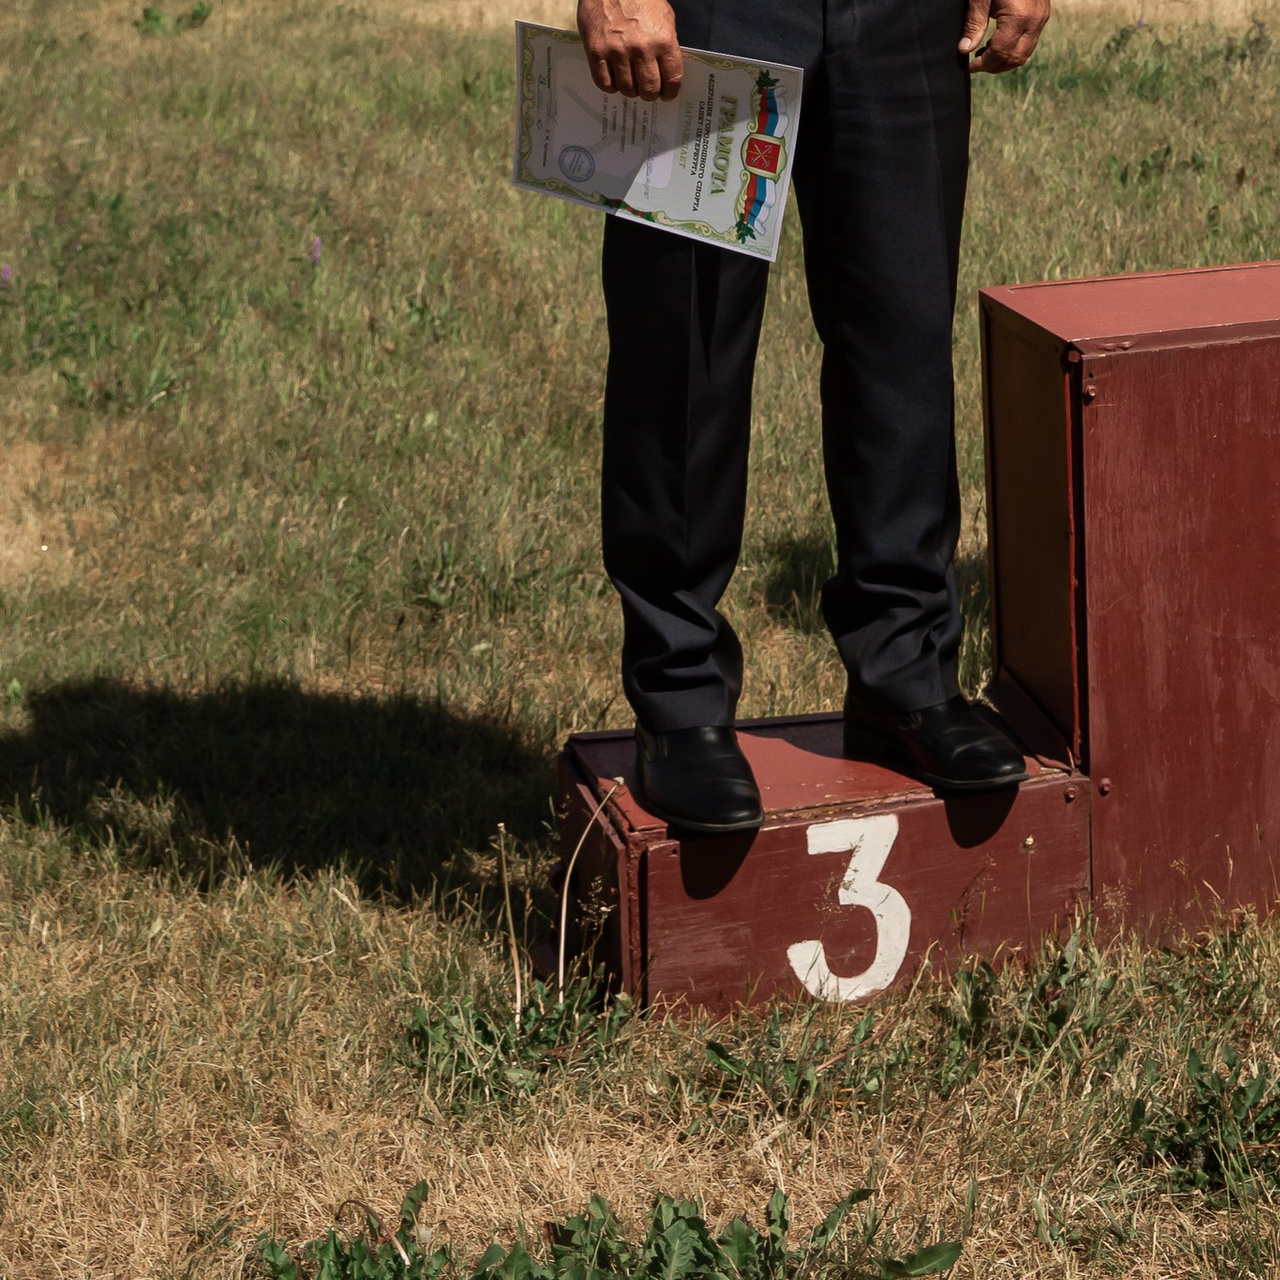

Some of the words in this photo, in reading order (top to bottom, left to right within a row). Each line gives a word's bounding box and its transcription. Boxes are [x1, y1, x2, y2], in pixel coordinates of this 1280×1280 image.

[706, 73, 716, 118] ФЕДЕРАЦИЯ
[678, 102, 694, 169] НАГРАЖДАЕТ
[690, 101, 706, 176] САНКТ-ПЕТЕРБУРГА
[698, 118, 711, 179] ГОРОДОШНОГО
[709, 94, 738, 196] ГРАМОТА
[692, 180, 703, 212] СПОРТА
[786, 813, 912, 1003] 3
